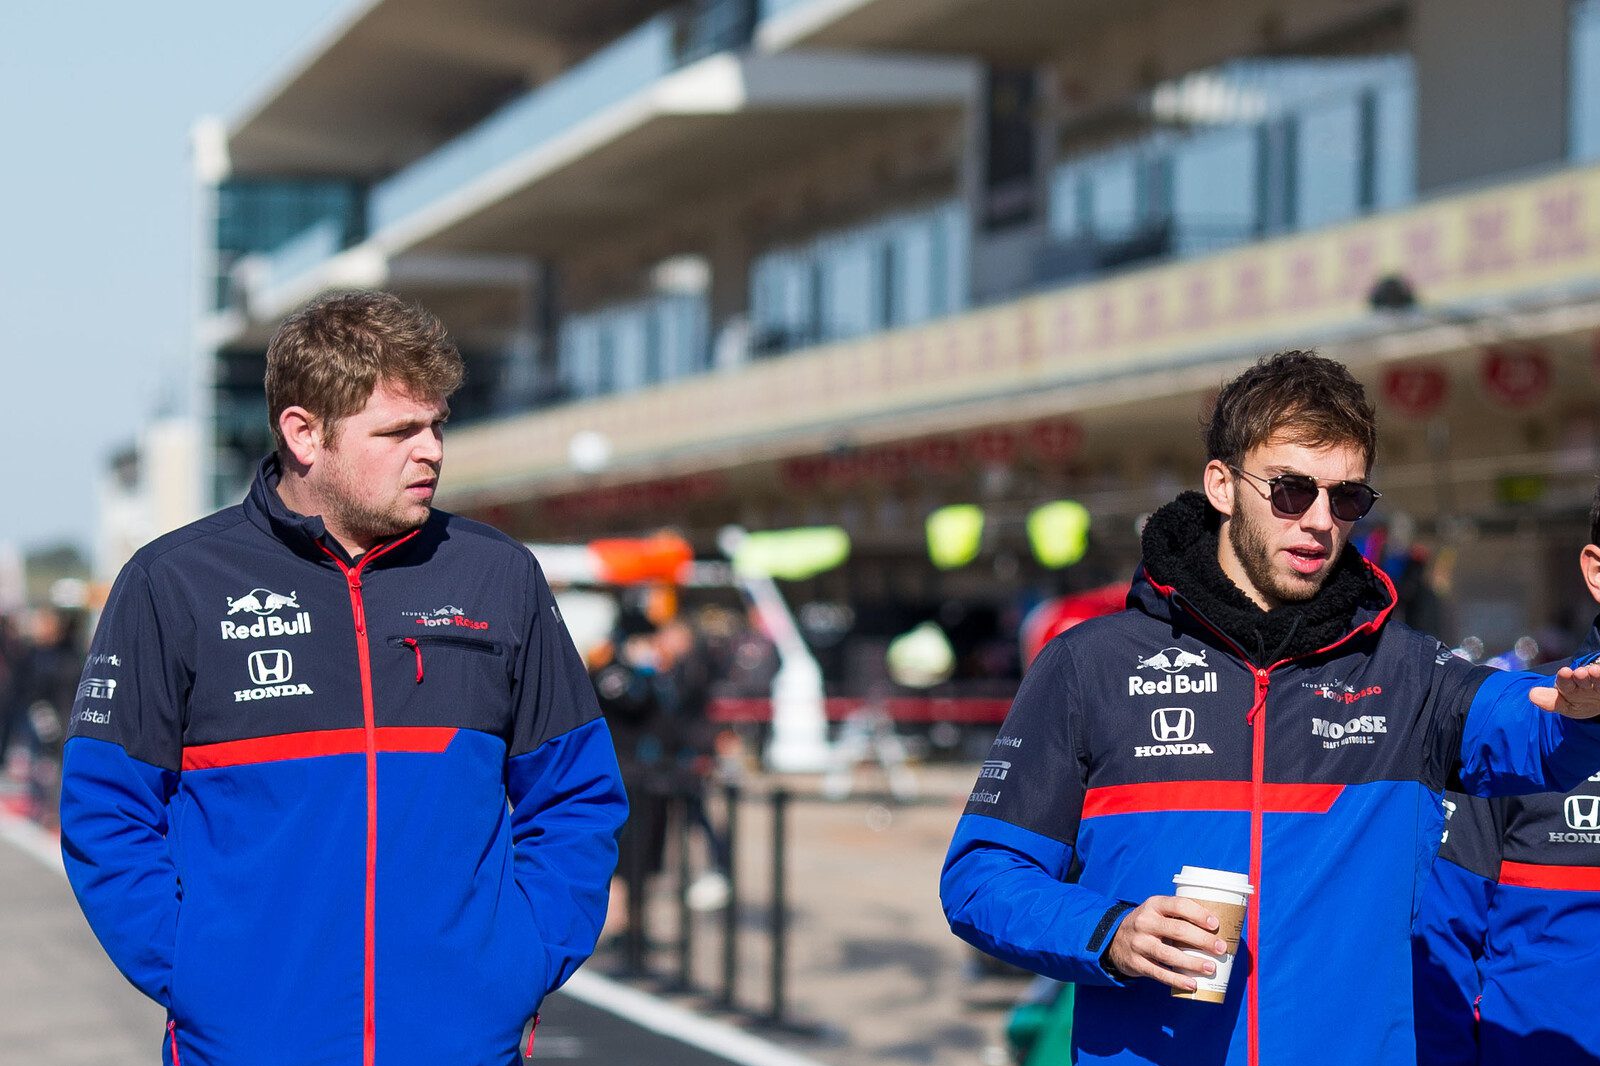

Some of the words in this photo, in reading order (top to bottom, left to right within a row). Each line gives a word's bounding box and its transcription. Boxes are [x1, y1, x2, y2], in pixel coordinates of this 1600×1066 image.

[220, 616, 266, 640] Red
[266, 612, 312, 636] Bull
[233, 683, 314, 702] HONDA
[1128, 674, 1172, 696] Red
[1174, 672, 1218, 694] Bull
[1311, 715, 1388, 739] MOOSE
[1134, 743, 1214, 757] HONDA
